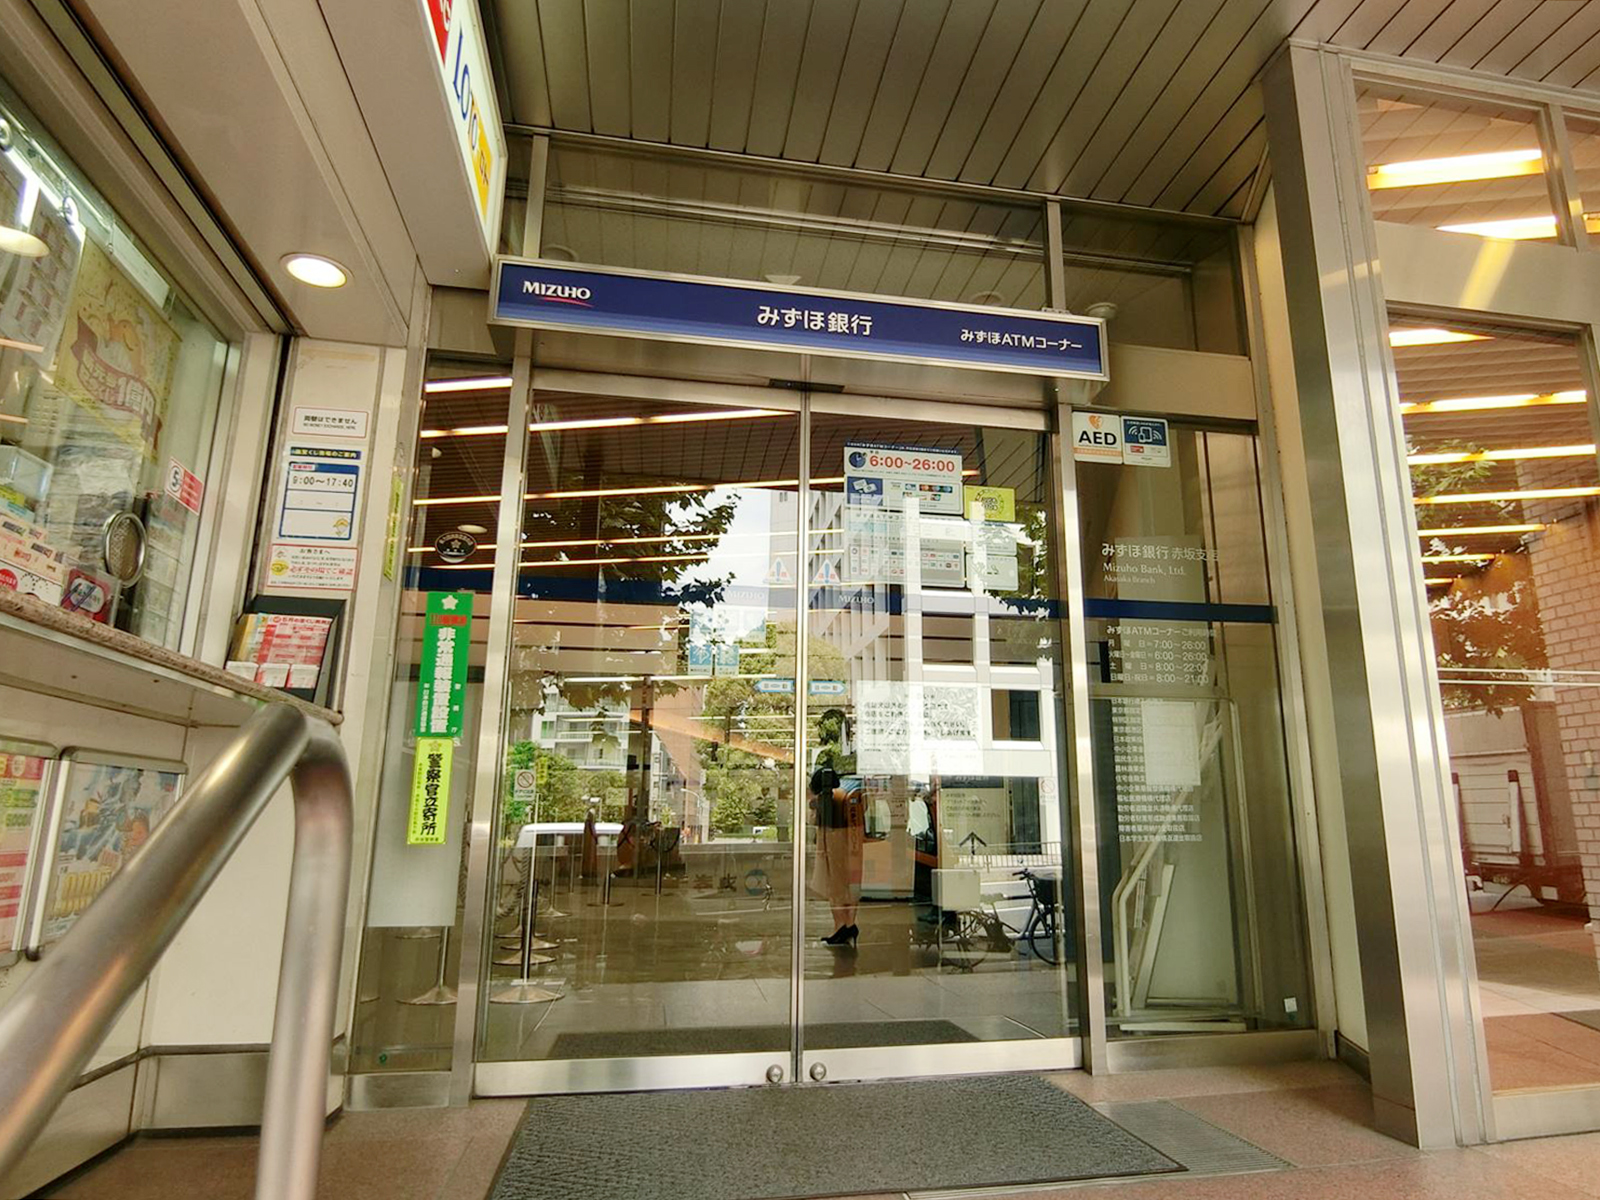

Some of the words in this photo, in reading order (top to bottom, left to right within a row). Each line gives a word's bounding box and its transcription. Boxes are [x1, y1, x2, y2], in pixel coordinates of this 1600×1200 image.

[453, 25, 478, 151] LOTO
[522, 280, 591, 300] MIZUHO
[757, 305, 873, 337] みずほ銀行
[960, 328, 1083, 351] みずほATMコーナー
[1079, 430, 1117, 446] AED
[869, 455, 955, 473] 6:00～26:00
[1101, 543, 1168, 560] みずほ銀行
[1103, 562, 1138, 574] Mizuho
[1141, 564, 1167, 576] Bank,
[420, 753, 443, 836] 警察官立寄所
